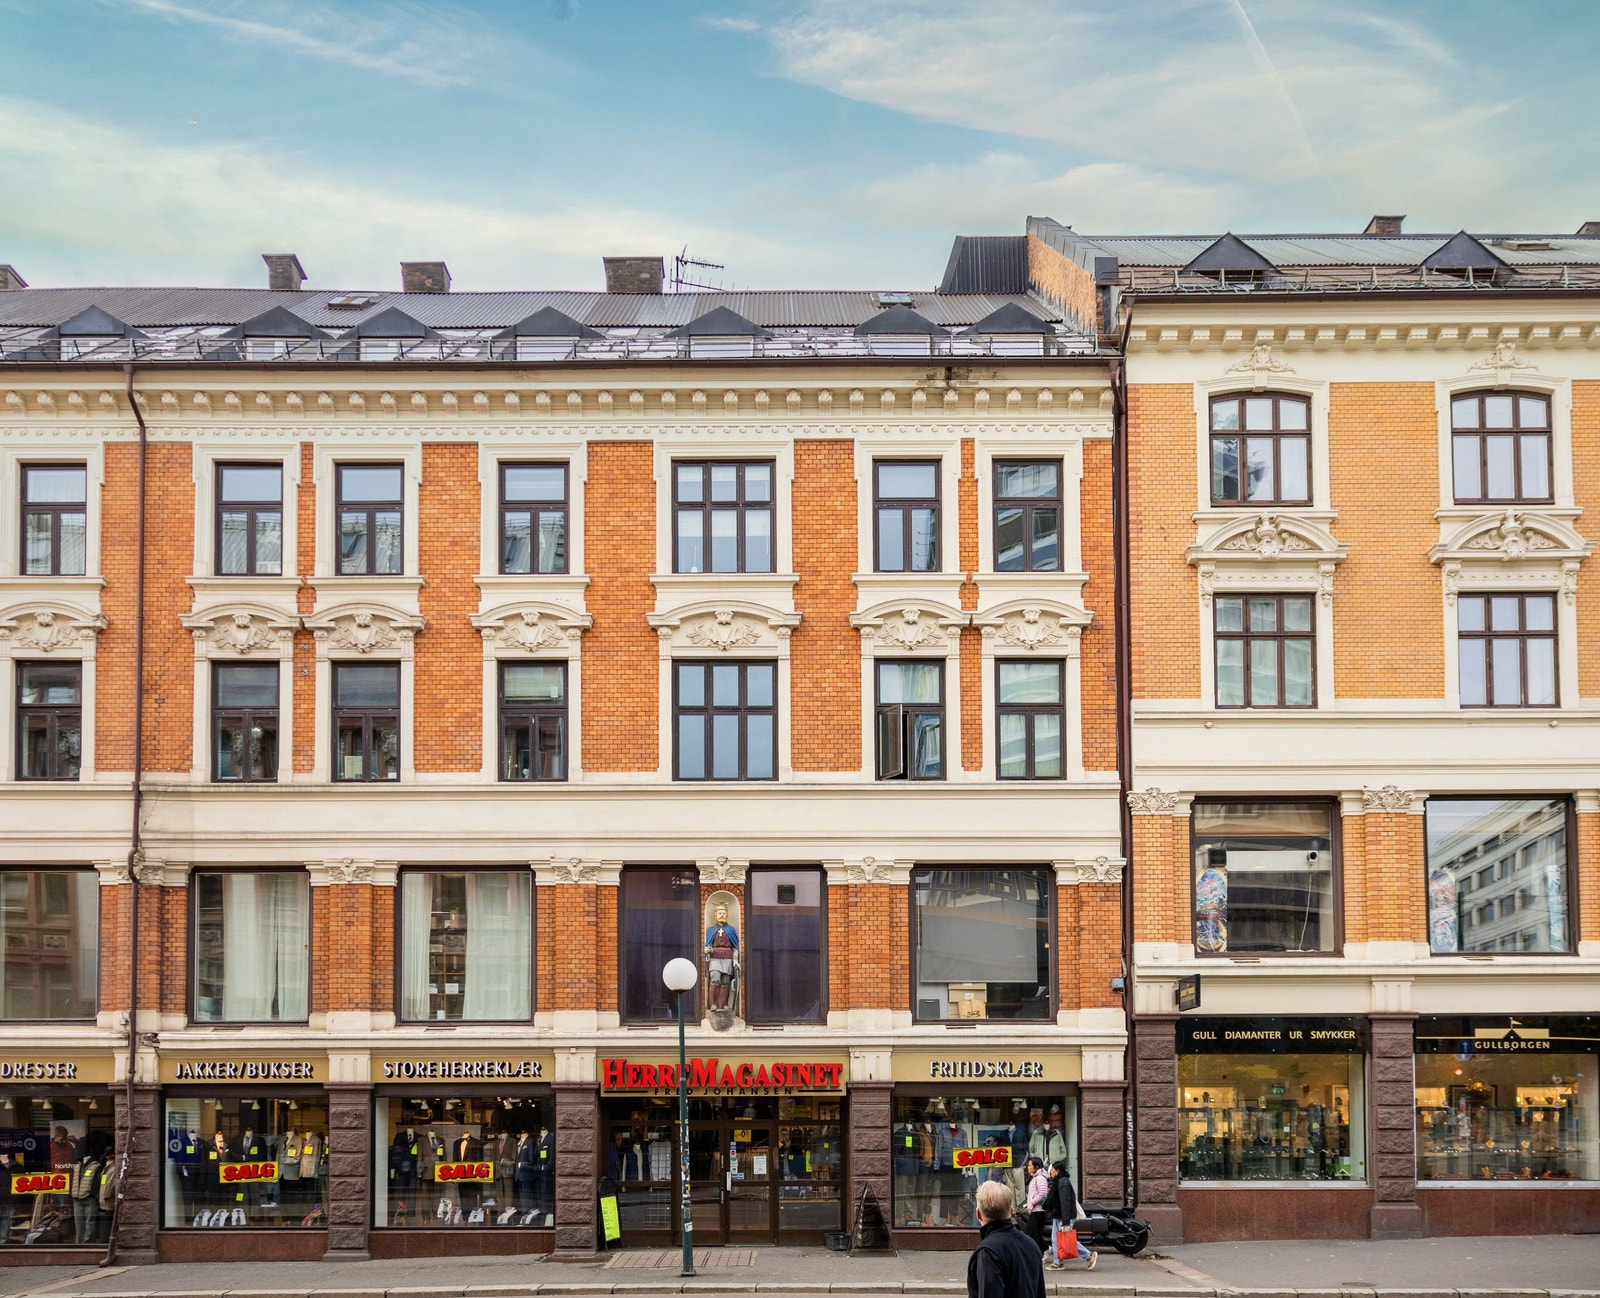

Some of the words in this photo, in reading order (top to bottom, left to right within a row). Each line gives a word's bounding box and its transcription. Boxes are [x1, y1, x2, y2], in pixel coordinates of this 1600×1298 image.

[1192, 1031, 1217, 1040] GULL
[1225, 1031, 1282, 1040] DIAMANTER
[1289, 1031, 1303, 1039] UR
[1310, 1030, 1356, 1039] SMYKKER
[1474, 1041, 1550, 1049] GULLBORGEN
[1, 1062, 77, 1079] DRESSER
[175, 1062, 313, 1079] JAKKER/BUKSER
[930, 1061, 1043, 1078] FRITIDSKLÆR
[956, 1147, 1009, 1167] SALG
[223, 1163, 277, 1181] SALG
[438, 1163, 490, 1181] SALG
[15, 1175, 66, 1193] SALG
